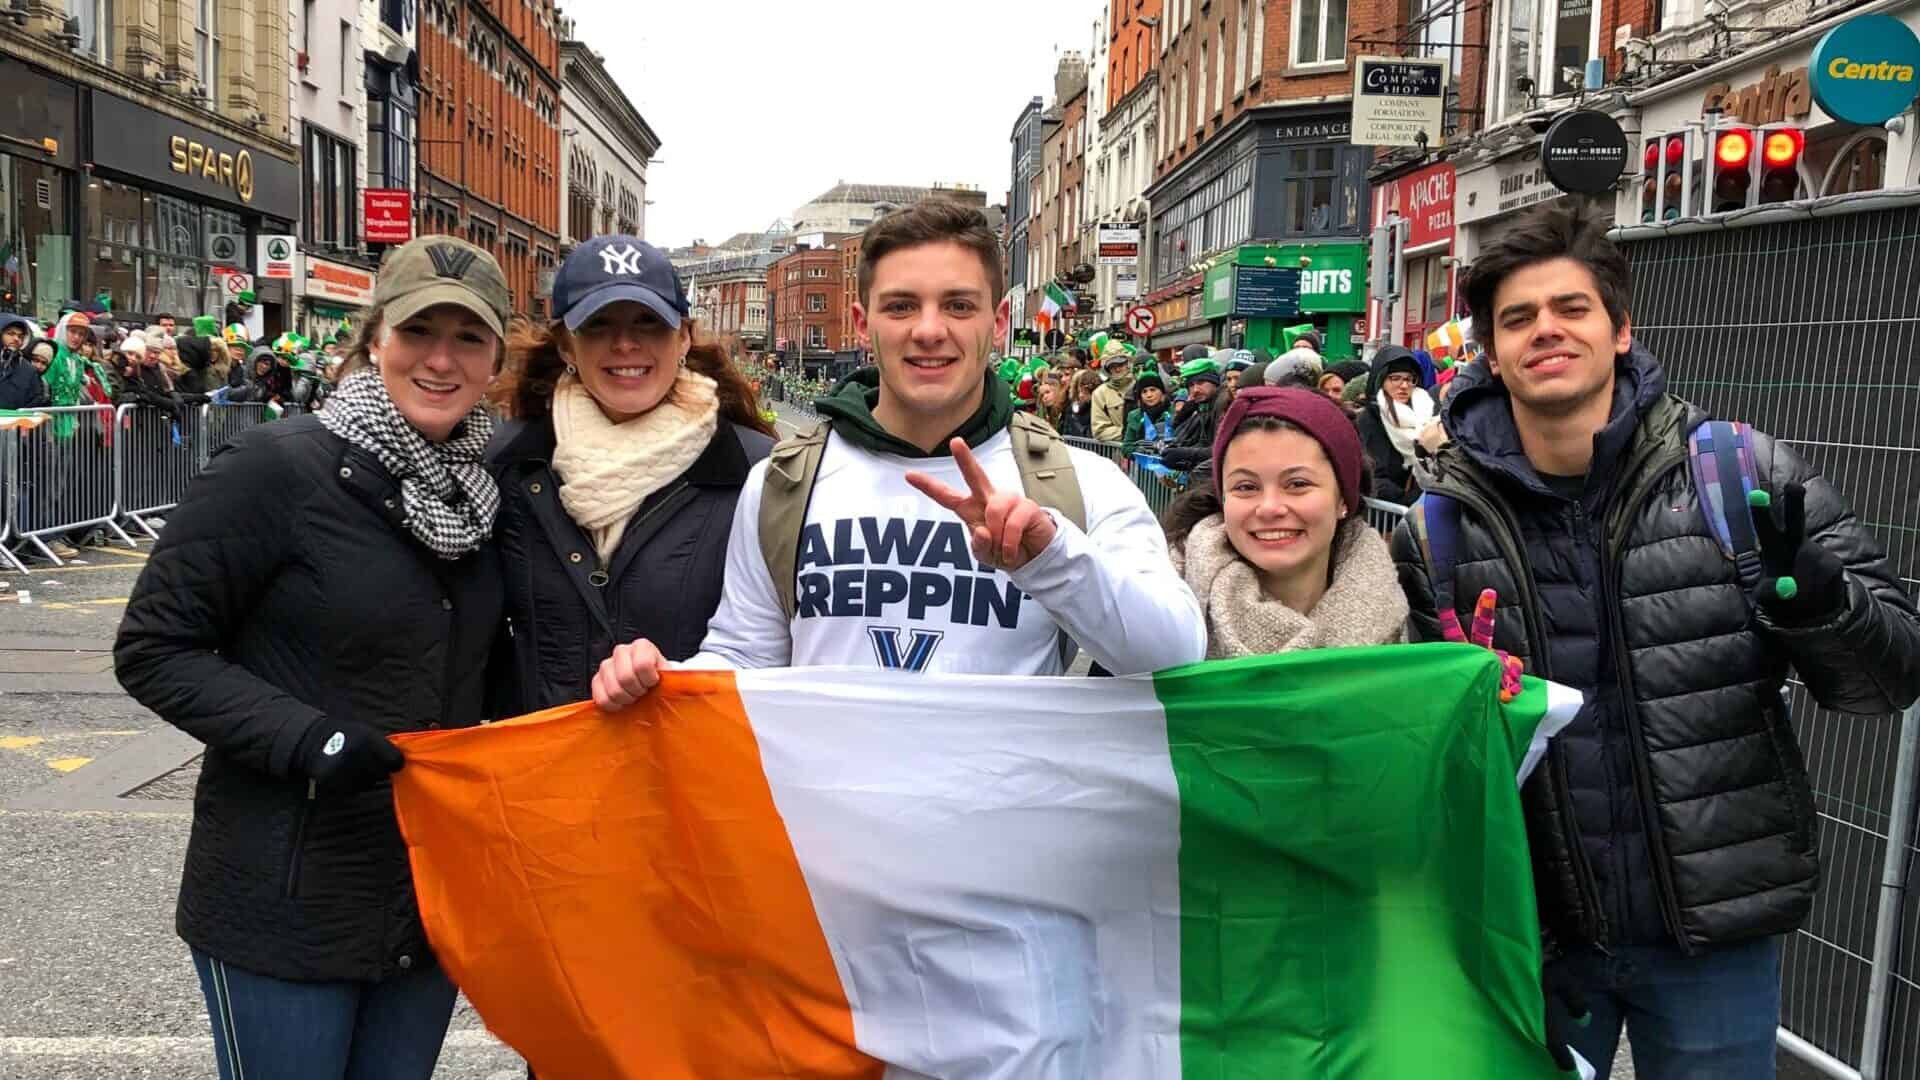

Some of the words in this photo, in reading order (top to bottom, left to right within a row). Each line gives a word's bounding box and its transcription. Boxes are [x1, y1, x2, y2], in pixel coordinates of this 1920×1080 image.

[1828, 57, 1914, 83] Centra
[1383, 86, 1420, 94] SHOP
[1702, 63, 1812, 127] Centra
[1373, 109, 1425, 118] FORMATIONS
[1379, 99, 1421, 107] COMPANY
[1276, 122, 1350, 138] ENTRANCE
[1370, 123, 1416, 132] CORPORATE
[169, 135, 234, 188] SPAR
[1551, 147, 1579, 155] FRANK
[1589, 147, 1622, 155] HONEST
[1408, 171, 1451, 221] APACHE
[1499, 173, 1524, 197] FRANK
[371, 199, 402, 208] Indian
[1428, 209, 1452, 233] PIZZA
[599, 244, 642, 275] NY
[1300, 269, 1353, 295] GIFTS
[800, 516, 996, 575] ALWA
